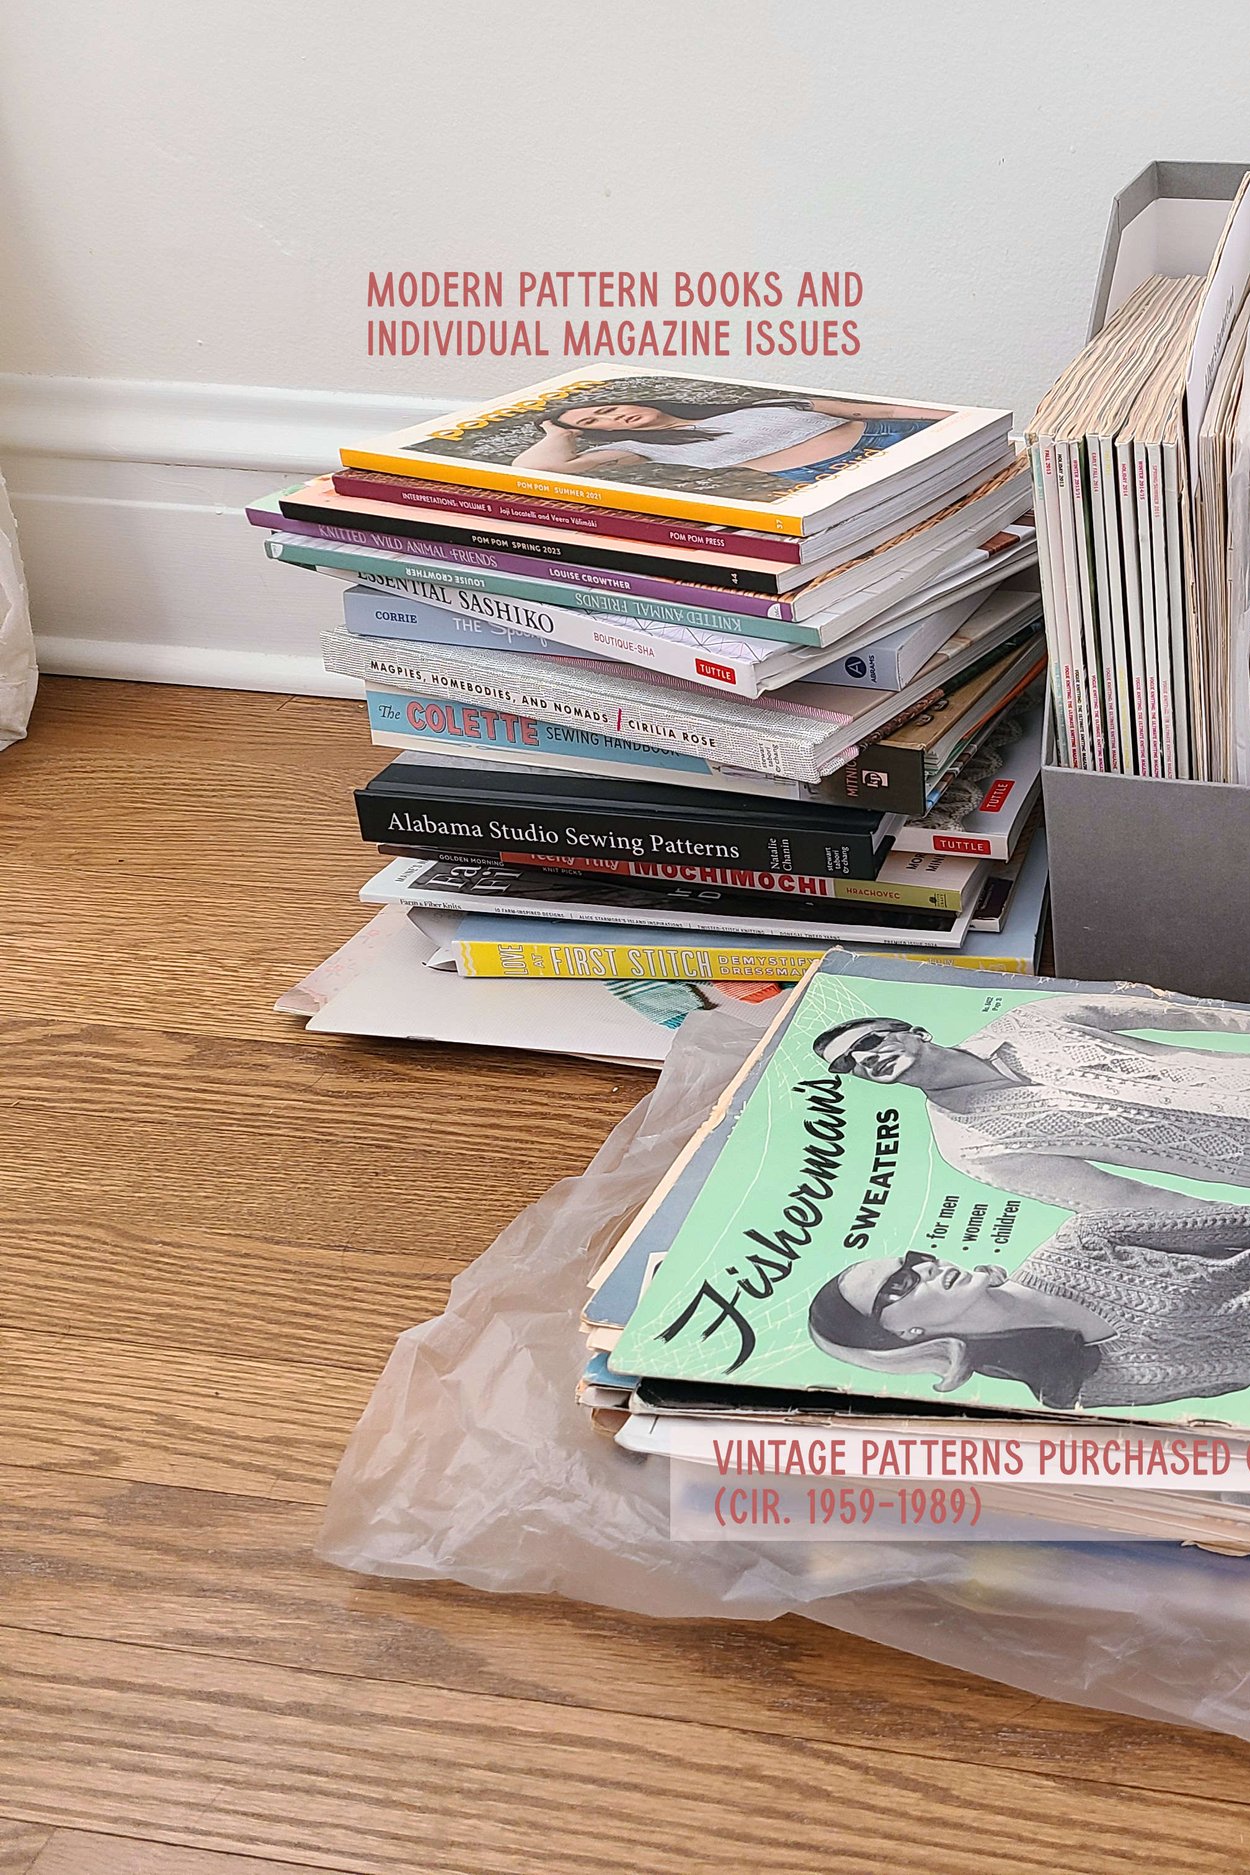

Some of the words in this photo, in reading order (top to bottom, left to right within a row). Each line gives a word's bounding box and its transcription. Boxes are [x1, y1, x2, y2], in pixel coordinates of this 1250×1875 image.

[516, 480, 533, 490] POM
[534, 483, 550, 492] POM
[554, 486, 585, 498] SUMMER
[586, 491, 602, 501] 2021
[402, 492, 458, 507] INTERPRETATIONS:
[458, 500, 485, 512] VOLUME
[486, 504, 492, 512] 8
[499, 507, 511, 516] Joji
[511, 507, 537, 520] Locatelli
[537, 512, 550, 522] and
[550, 514, 570, 524] Veera
[472, 535, 490, 545] POM
[491, 538, 509, 548] POM
[512, 541, 541, 554] SPRING
[542, 545, 562, 556] 2023
[670, 531, 685, 542] POM
[687, 533, 703, 544] POM
[704, 536, 726, 548] PRESS
[318, 524, 367, 544] KNITTED
[370, 533, 403, 550] WILD
[406, 540, 448, 560] ANIMAL
[449, 548, 498, 569] FRIENDS
[549, 567, 581, 582] LOUISE
[581, 571, 632, 590] CROWTHER
[405, 566, 454, 584] CROWTHER
[455, 574, 486, 588] LOUISE
[575, 592, 628, 614] FRIENDS
[634, 602, 684, 623] ANIMAL
[375, 610, 418, 624] CORRIE
[452, 617, 483, 633] THE
[686, 611, 742, 633] KNITTED
[457, 590, 555, 635] SASHIKO
[594, 631, 655, 658] BOUTIQUE-SHA
[699, 663, 733, 681] TUTTLE
[869, 654, 877, 684] ABRAMS
[370, 660, 427, 683] MAGPIES,
[431, 673, 516, 704] HOMEBODIES,
[521, 695, 548, 710] AND
[553, 702, 609, 723] NOMADS
[628, 718, 677, 739] CIRILIA
[682, 731, 718, 749] ROSE
[378, 704, 401, 721] The
[405, 700, 540, 747] COLETTE
[545, 726, 600, 747] SEWING
[985, 783, 1009, 809] TUTTLE
[387, 812, 484, 838] Alabama
[489, 820, 560, 845] Studio
[565, 827, 645, 855] Sewing
[650, 834, 740, 860] Patterns
[940, 839, 985, 852] TUTTLE
[438, 853, 470, 864] GOLDEN
[470, 857, 505, 868] MORNING
[768, 837, 781, 870] Natalie
[780, 838, 793, 872] Chanin
[825, 846, 834, 871] stewart
[542, 866, 560, 874] KNIT
[561, 868, 583, 876] PICKS
[634, 861, 828, 896] MOCHIMOCHI
[846, 887, 901, 900] HRACHOVEC
[400, 898, 419, 908] Farm
[424, 900, 442, 909] Fiber
[441, 902, 462, 911] Knits
[498, 943, 524, 976] LOVE
[533, 953, 546, 969] AT
[549, 946, 618, 977] FIRST
[631, 948, 713, 979] STITCH
[718, 954, 820, 970] DEMYSTIFY
[719, 963, 810, 977] DRESSMA
[843, 1107, 900, 1250] SWEATERS
[936, 1194, 960, 1219] men
[927, 1220, 948, 1241] for
[963, 1202, 989, 1243] women
[990, 1198, 1022, 1247] children
